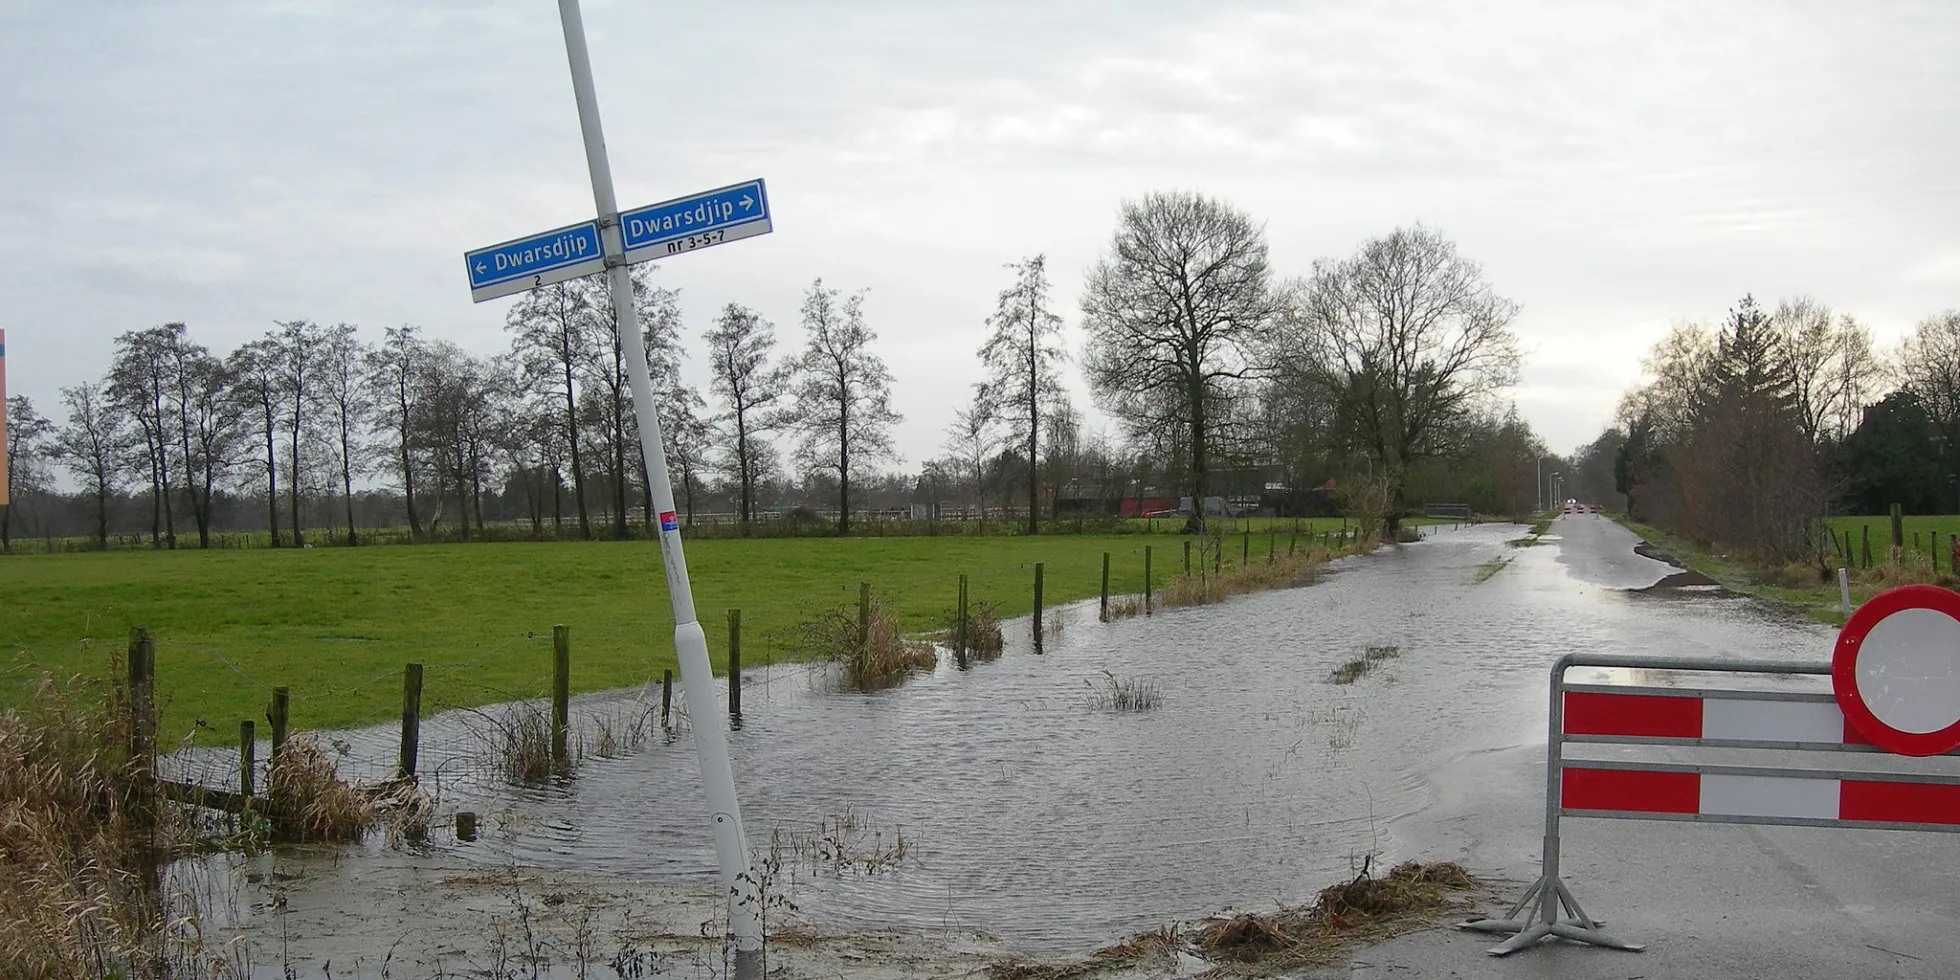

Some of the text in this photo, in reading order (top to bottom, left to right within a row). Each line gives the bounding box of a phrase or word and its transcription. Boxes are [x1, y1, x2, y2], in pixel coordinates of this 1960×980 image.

[629, 199, 734, 239] Dwarsdjip
[494, 232, 588, 271] Dwarsdjip
[667, 230, 725, 254] nr 3-5-7
[534, 275, 542, 287] 2
